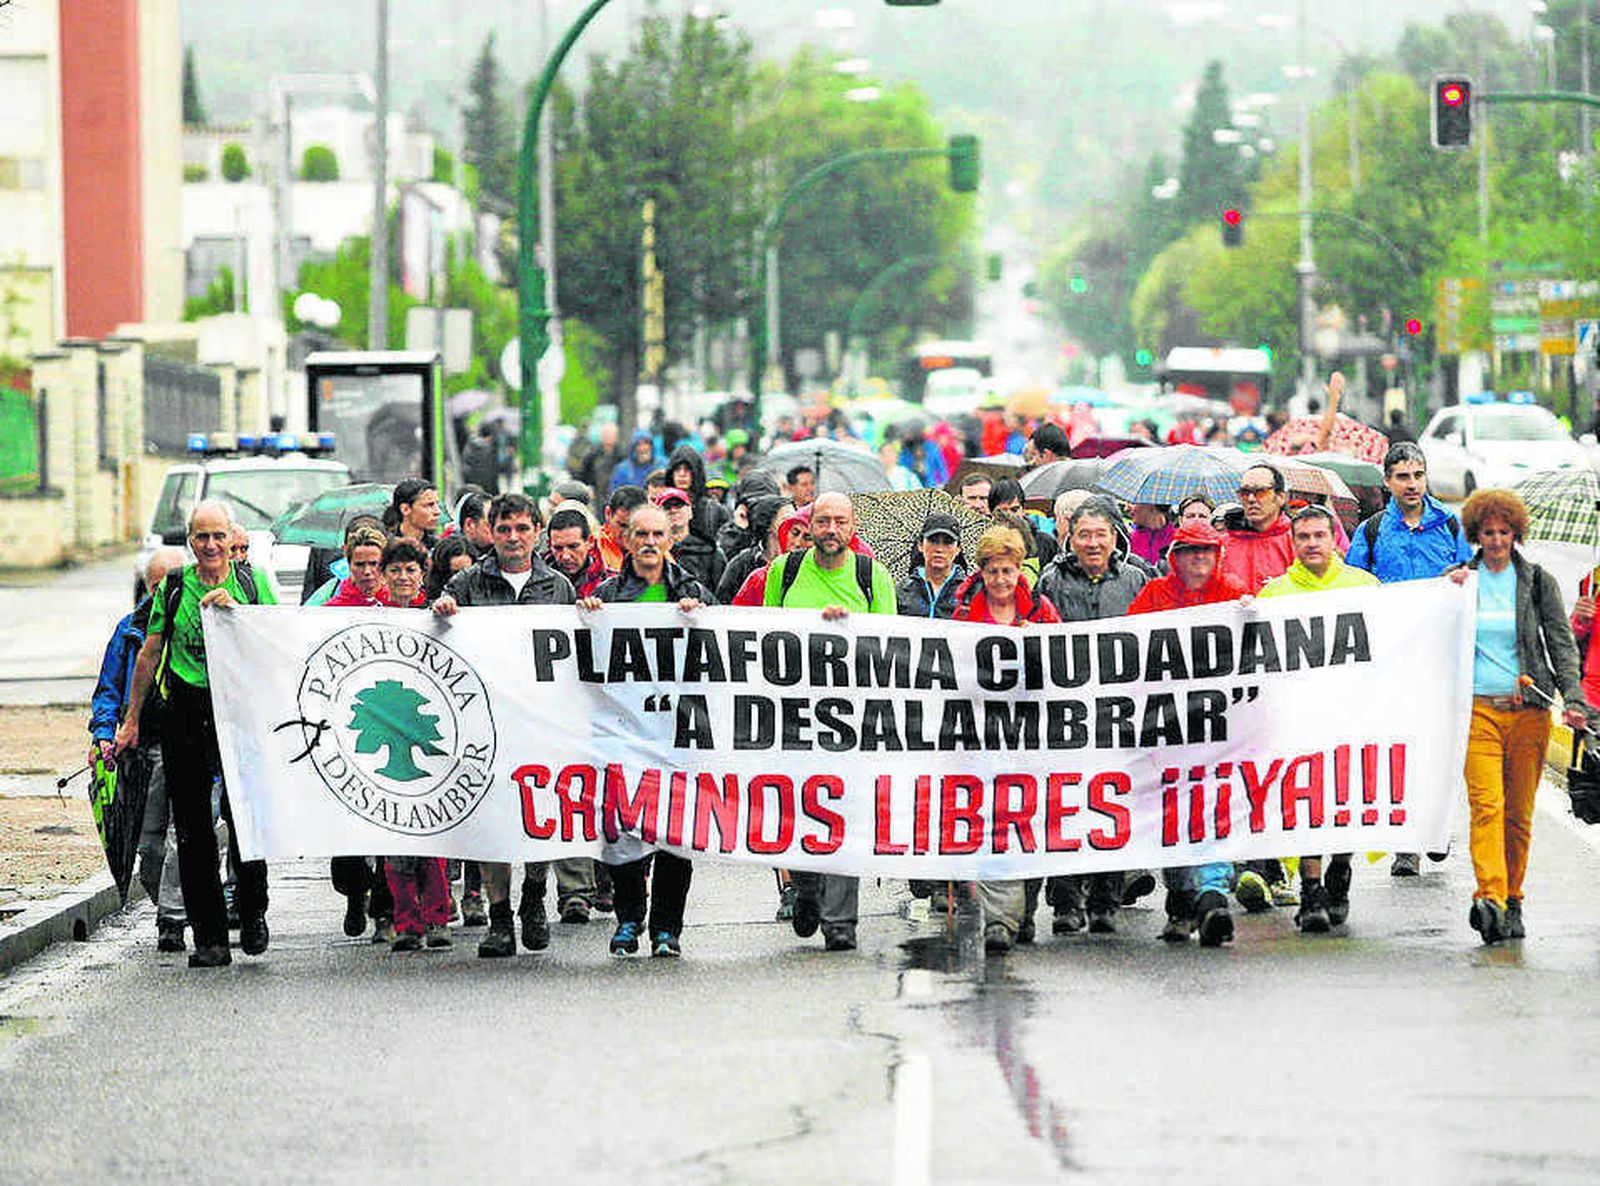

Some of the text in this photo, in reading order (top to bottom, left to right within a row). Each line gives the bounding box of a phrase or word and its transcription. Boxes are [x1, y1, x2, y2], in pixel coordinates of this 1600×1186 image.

[533, 613, 1371, 691] PLATAFORMA CIUDADANA
[734, 686, 1259, 752] DESALAMBRAR”
[511, 744, 1407, 855] CAMINOS LIBRES ¡¡¡YA!!!
